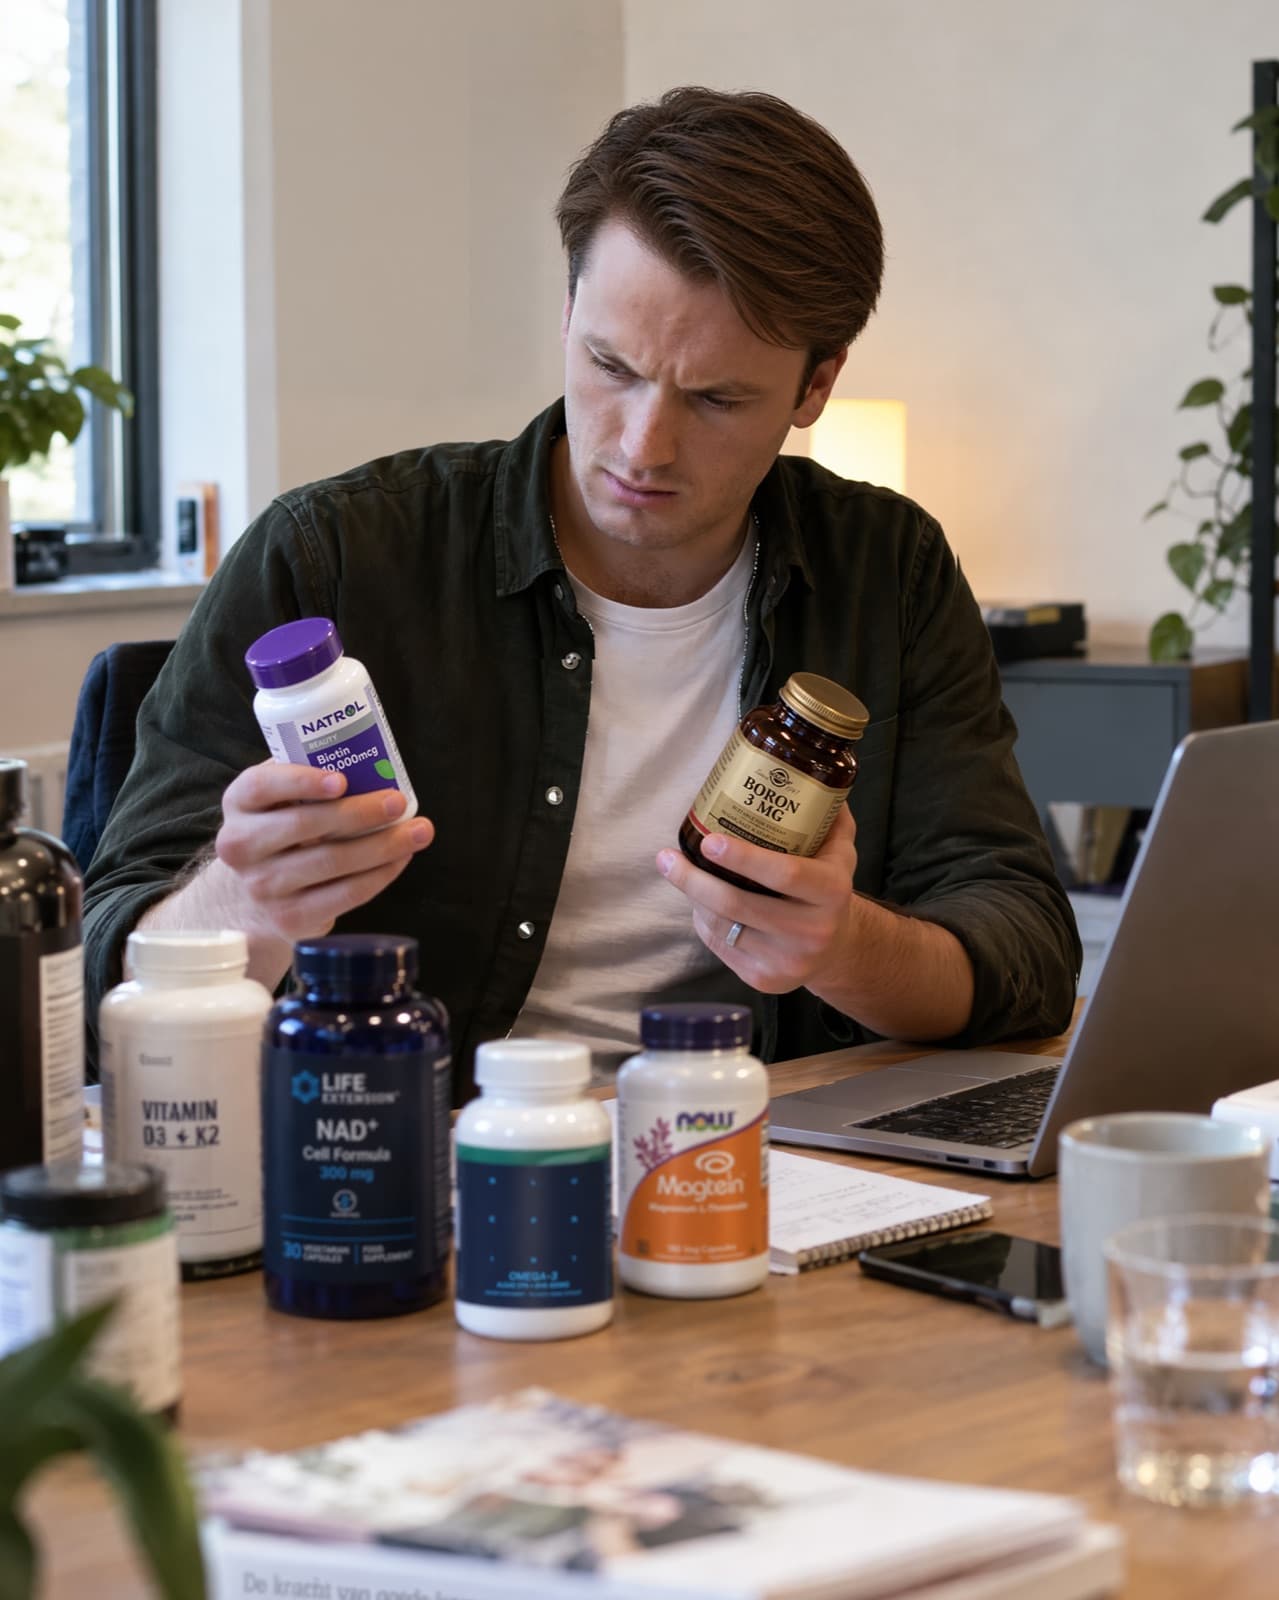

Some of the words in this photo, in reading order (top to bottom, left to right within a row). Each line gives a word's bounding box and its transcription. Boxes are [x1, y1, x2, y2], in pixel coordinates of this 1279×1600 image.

[302, 700, 365, 736] NATROL
[317, 746, 351, 765] Biotin
[743, 776, 801, 814] BORON
[743, 793, 755, 806] 3
[756, 800, 785, 822] MG
[322, 1073, 367, 1092] LIFE
[322, 1092, 395, 1104] EXTENSION
[142, 1100, 218, 1122] VITAMIN
[675, 1111, 735, 1132] now
[144, 1126, 167, 1146] D3
[176, 1130, 189, 1145] +
[195, 1125, 220, 1146] K2
[316, 1118, 379, 1142] NAD+
[302, 1145, 330, 1161] Cell
[333, 1146, 392, 1162] Formula
[320, 1165, 347, 1180] 300
[350, 1168, 375, 1184] mg
[282, 1241, 302, 1259] 30
[243, 1572, 268, 1594] De
[274, 1574, 332, 1600] kracht
